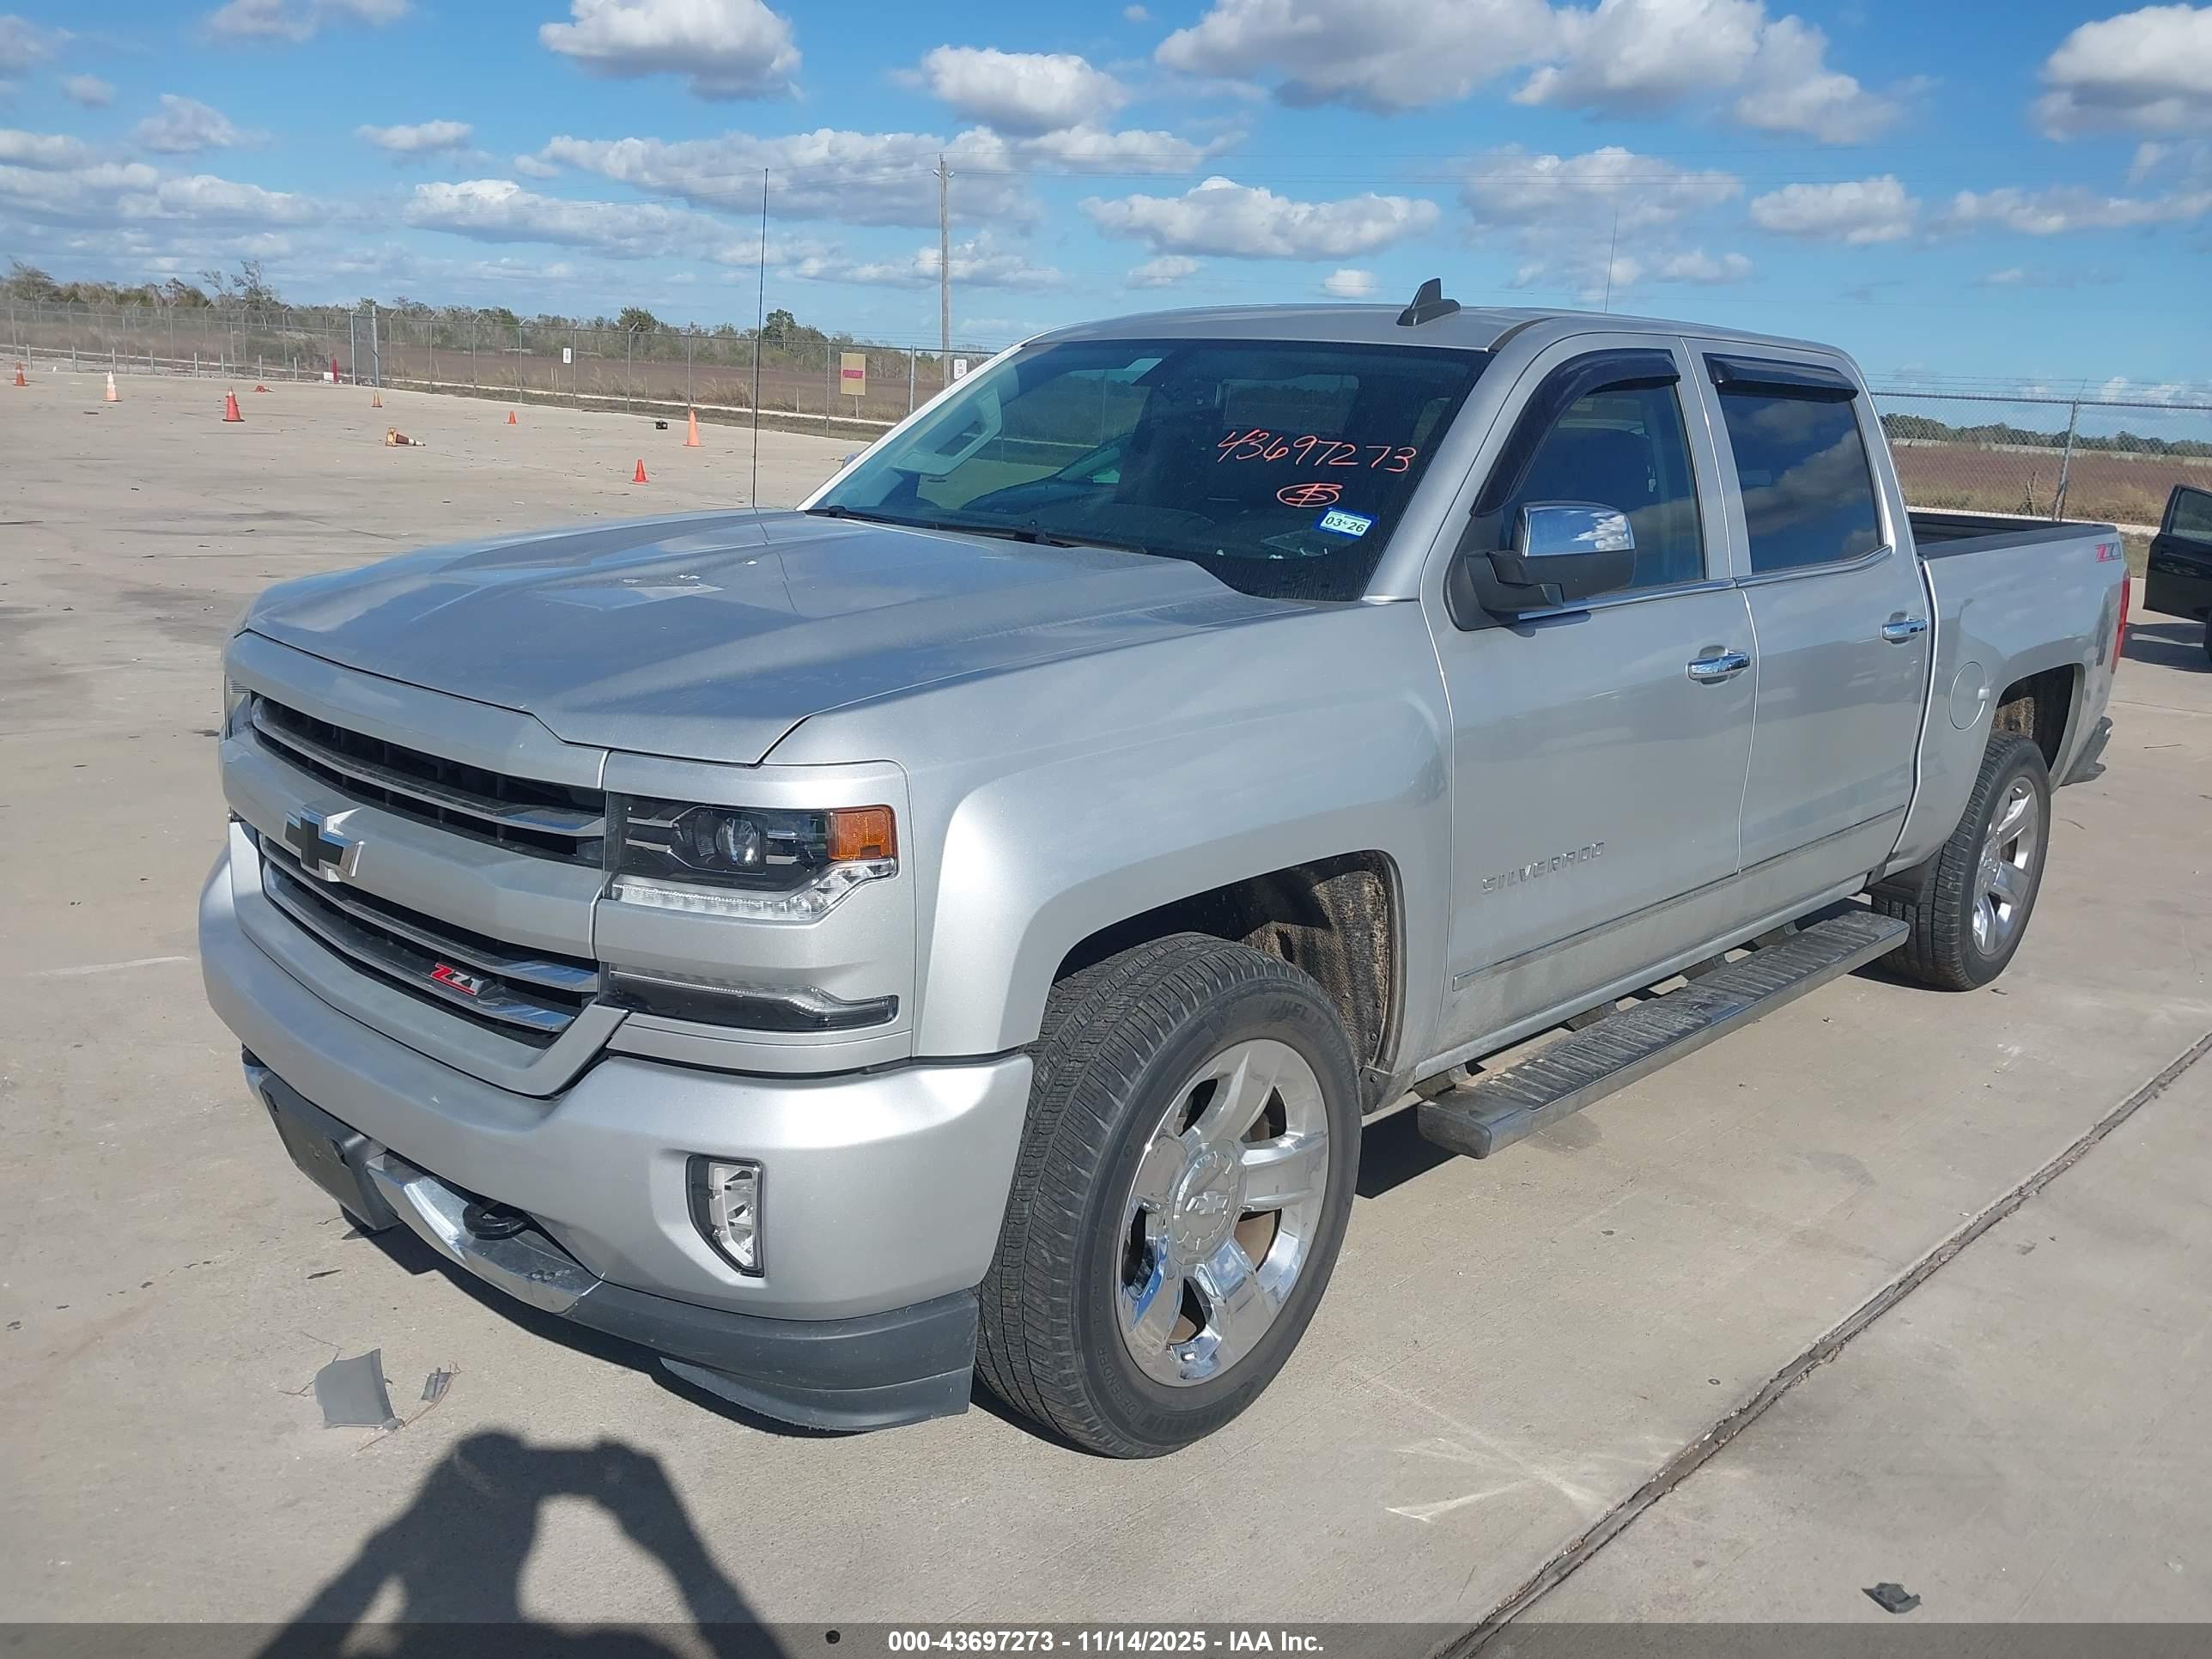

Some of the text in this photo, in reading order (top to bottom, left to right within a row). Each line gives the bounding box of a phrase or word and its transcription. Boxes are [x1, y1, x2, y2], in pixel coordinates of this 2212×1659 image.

[1217, 428, 1417, 472] 43697273
[1325, 516, 1365, 532] 03 26
[1481, 842, 1605, 894] SILVERADO
[429, 962, 483, 996] Z71
